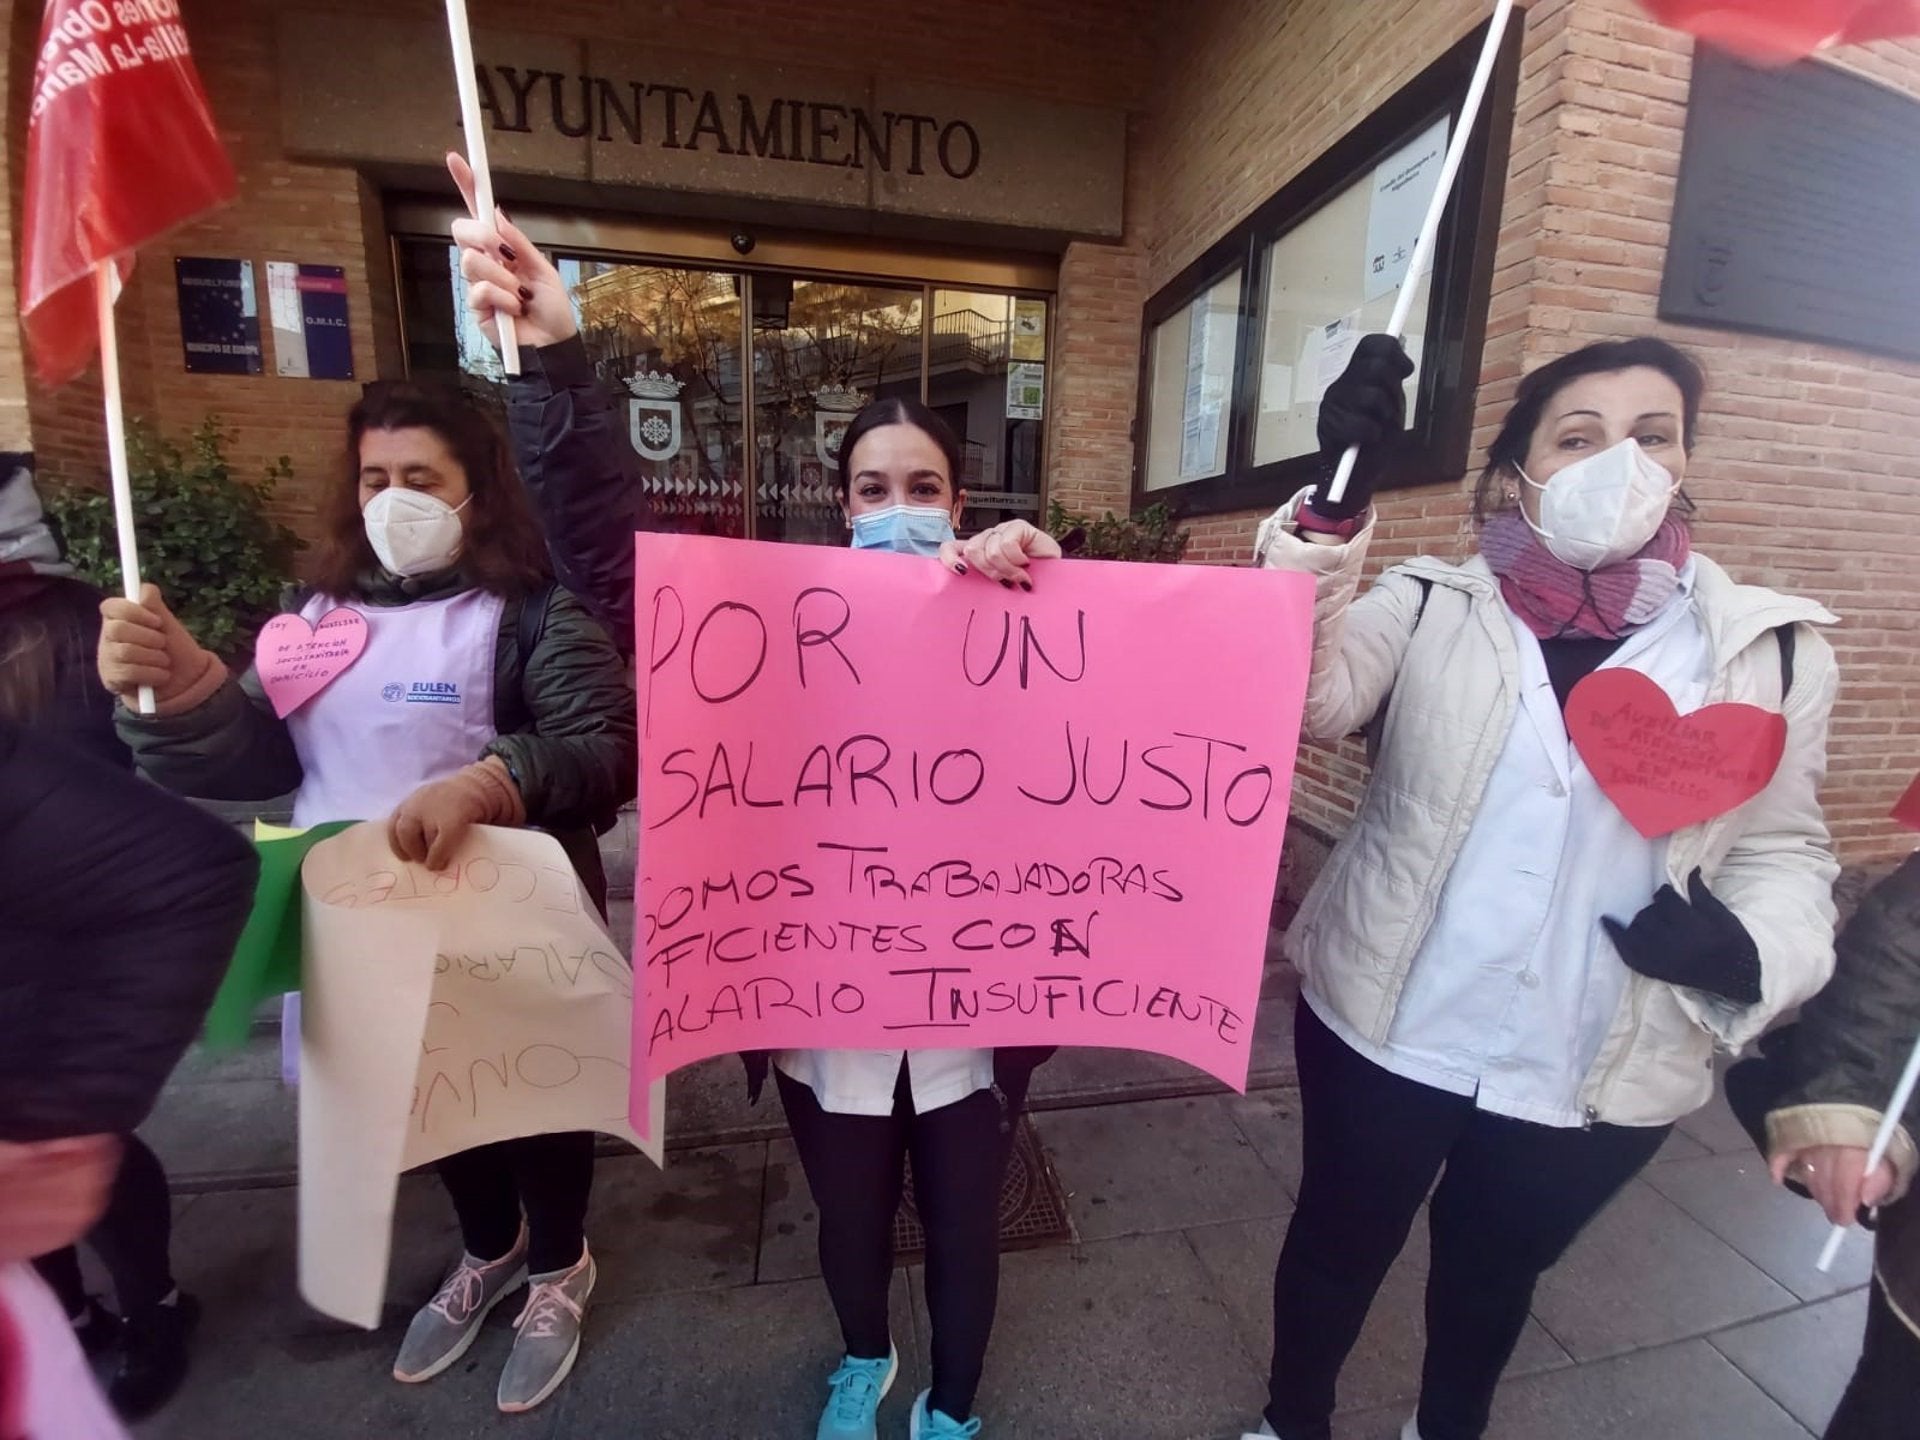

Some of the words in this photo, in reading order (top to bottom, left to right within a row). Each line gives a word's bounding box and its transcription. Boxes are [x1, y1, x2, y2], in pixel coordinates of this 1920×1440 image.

[457, 63, 981, 180] AYUNTAMIENTO
[412, 682, 457, 694] EULEN
[646, 584, 861, 739] POR
[962, 608, 1085, 690] UN
[648, 733, 985, 830] SALARIO
[1017, 721, 1272, 827] JUSTO
[817, 842, 1183, 902] TRABAJADORAS
[648, 921, 927, 988] FICIENTES
[648, 976, 865, 1057] ALARIO
[883, 967, 1245, 1045] INSUFICIENTE
